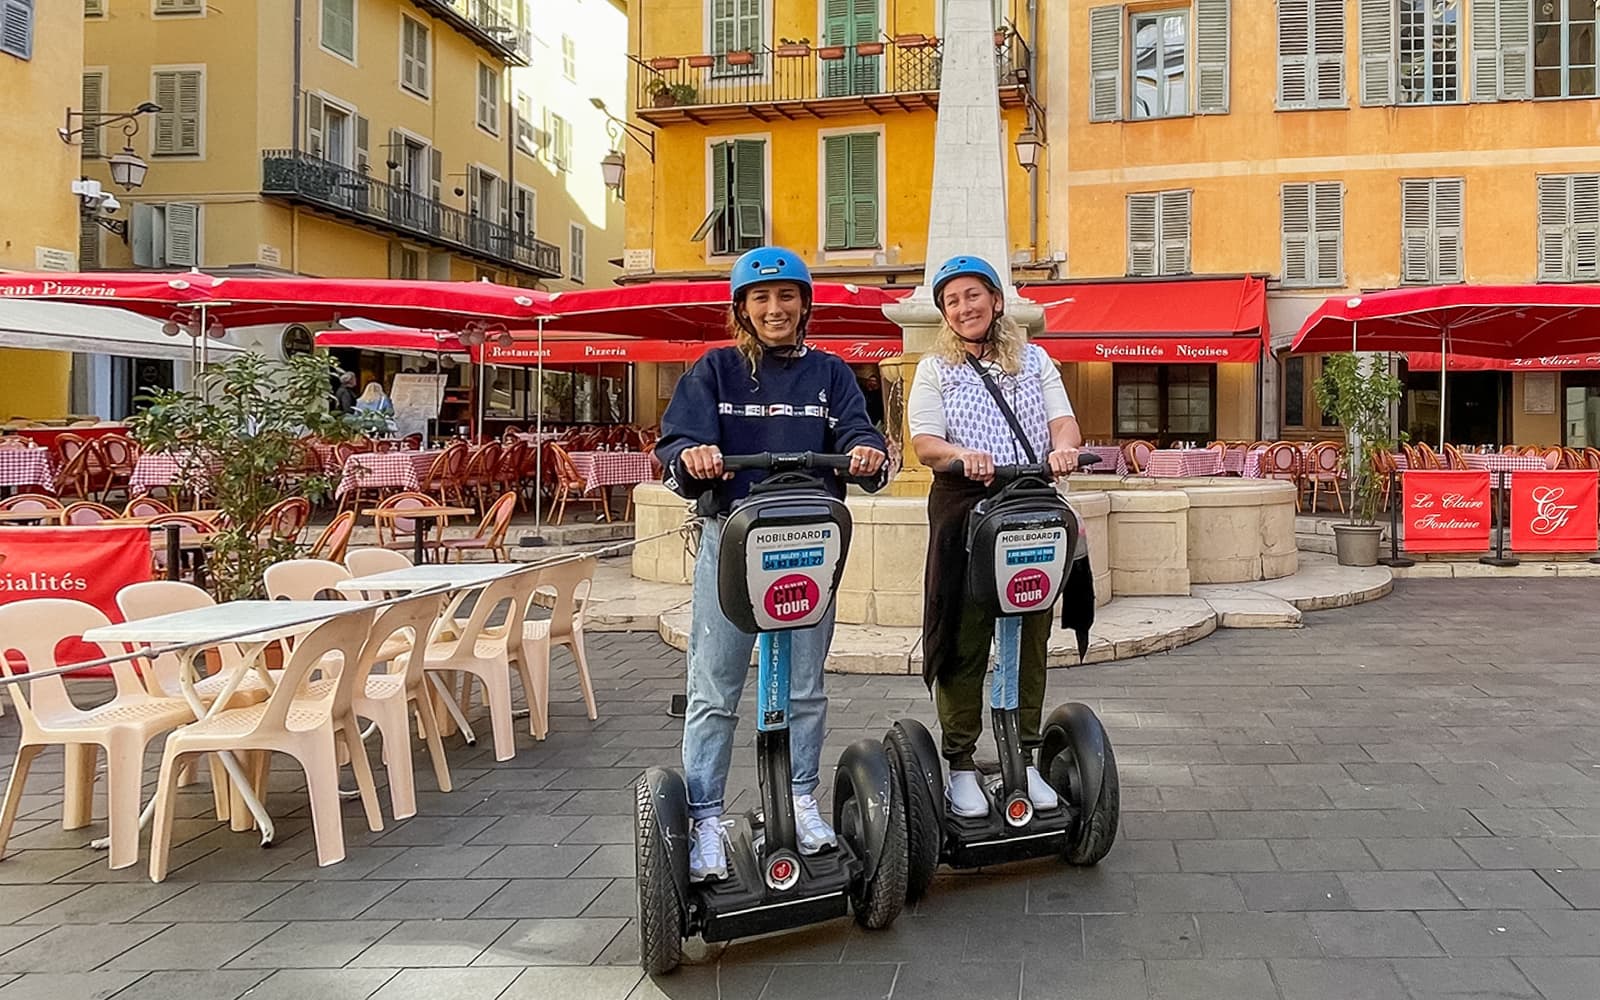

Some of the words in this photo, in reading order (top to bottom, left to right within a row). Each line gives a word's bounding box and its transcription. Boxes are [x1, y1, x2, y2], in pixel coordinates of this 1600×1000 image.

[41, 280, 117, 296] Pizzeria
[492, 346, 551, 357] Restaurant
[584, 346, 627, 356] Pizzeria
[843, 342, 903, 358] Fontain
[1095, 343, 1164, 358] Spécialités
[1176, 344, 1229, 358] Niçoises
[1510, 358, 1533, 367] La
[1538, 355, 1580, 366] Claire
[1411, 493, 1435, 509] La
[1441, 492, 1484, 509] Claire
[1414, 513, 1480, 529] Fontaine
[756, 530, 821, 544] MOBILBOARD
[1002, 531, 1053, 543] MOBILBOARD
[773, 584, 808, 605] CITY
[1014, 589, 1042, 604] TOUR
[774, 598, 810, 616] TOUR
